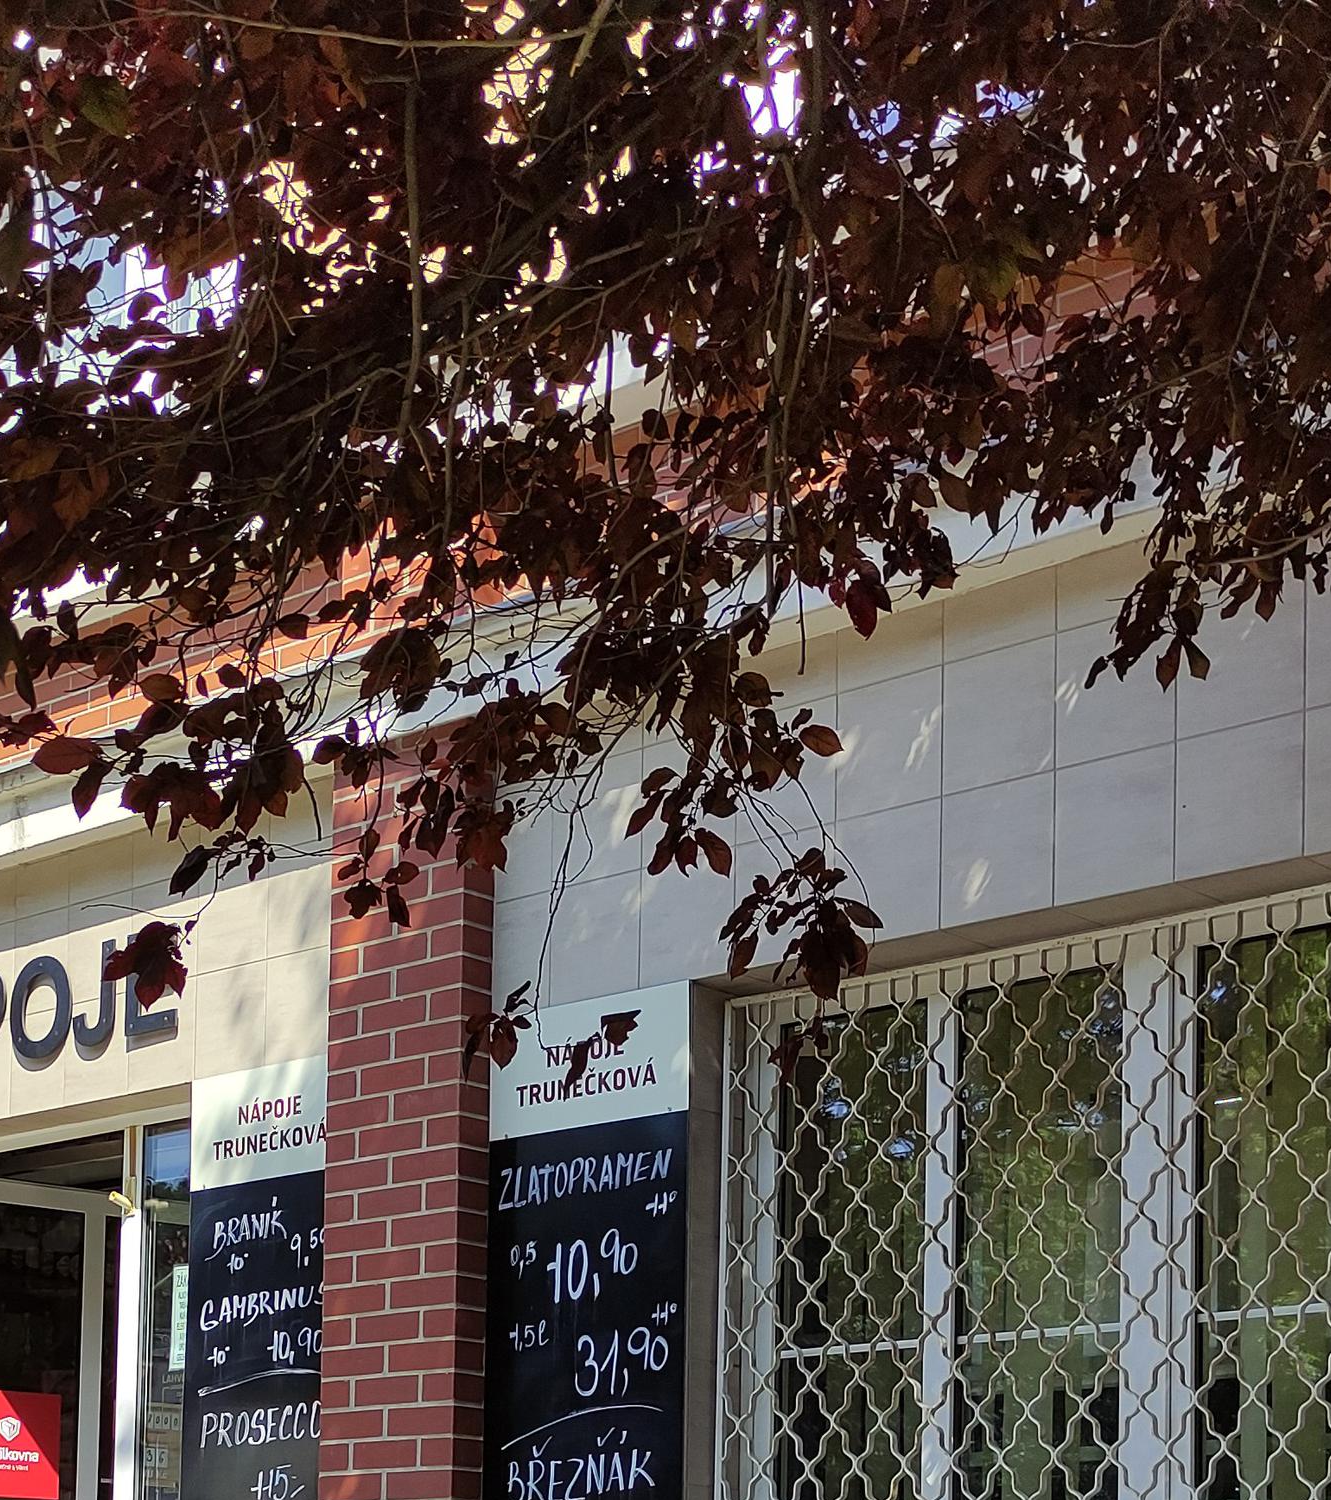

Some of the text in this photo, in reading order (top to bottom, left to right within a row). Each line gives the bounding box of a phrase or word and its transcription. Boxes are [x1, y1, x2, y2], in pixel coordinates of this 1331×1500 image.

[547, 1036, 625, 1068] NÁOJE
[516, 1057, 657, 1107] TRUNEČKOVÁ
[238, 1095, 302, 1126] NÁPOJE
[213, 1117, 327, 1161] TRUNEČKOVÁ
[498, 1148, 672, 1211] ZLATOPRAMEN
[546, 1228, 638, 1303] 10,90
[267, 1327, 323, 1366] 10,90
[575, 1326, 669, 1397] 31,90
